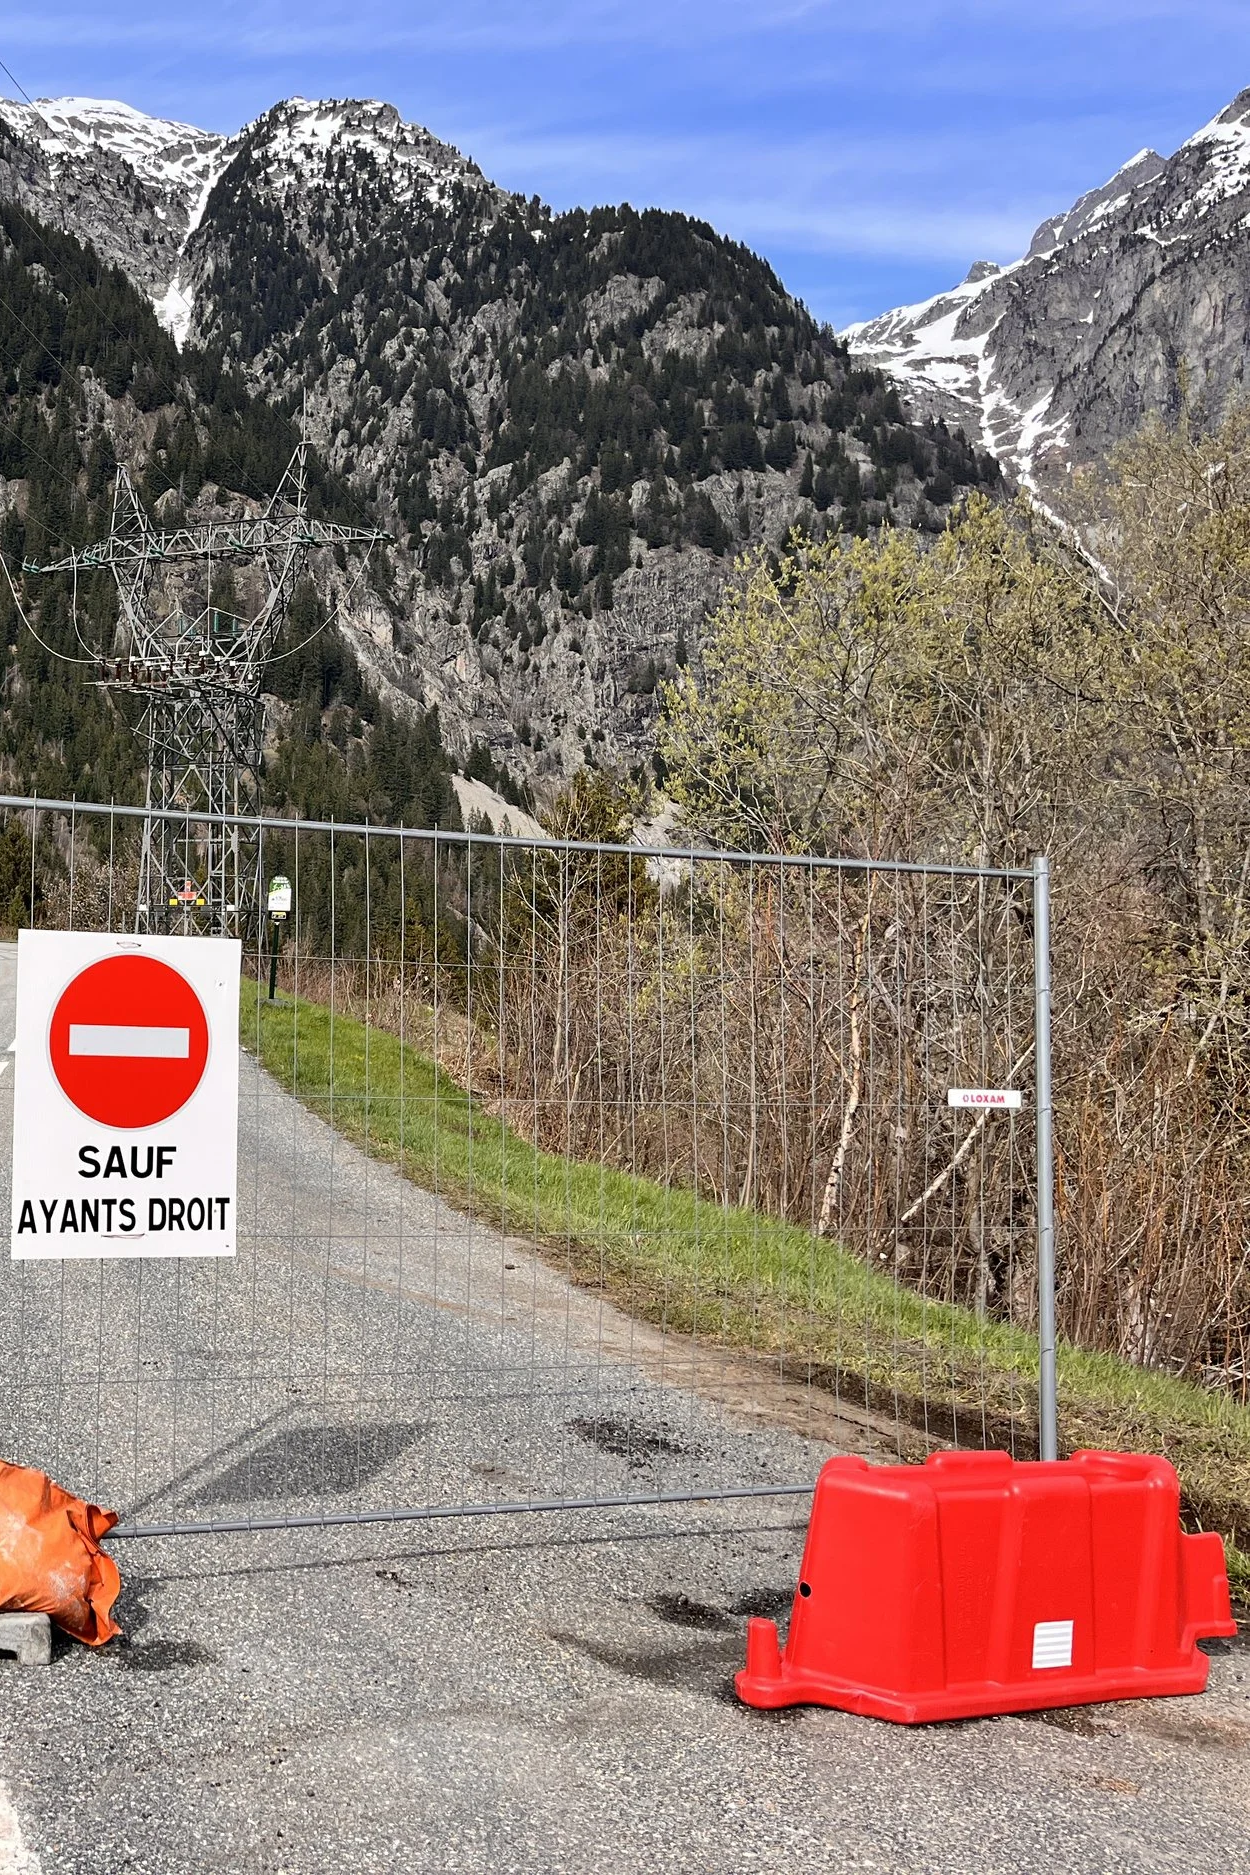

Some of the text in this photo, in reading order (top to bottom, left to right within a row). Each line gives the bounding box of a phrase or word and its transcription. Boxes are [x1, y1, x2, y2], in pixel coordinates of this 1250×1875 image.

[970, 1094, 1005, 1104] LOXAM
[78, 1145, 177, 1179] SAUF
[17, 1197, 230, 1234] AYANTS DROIT
